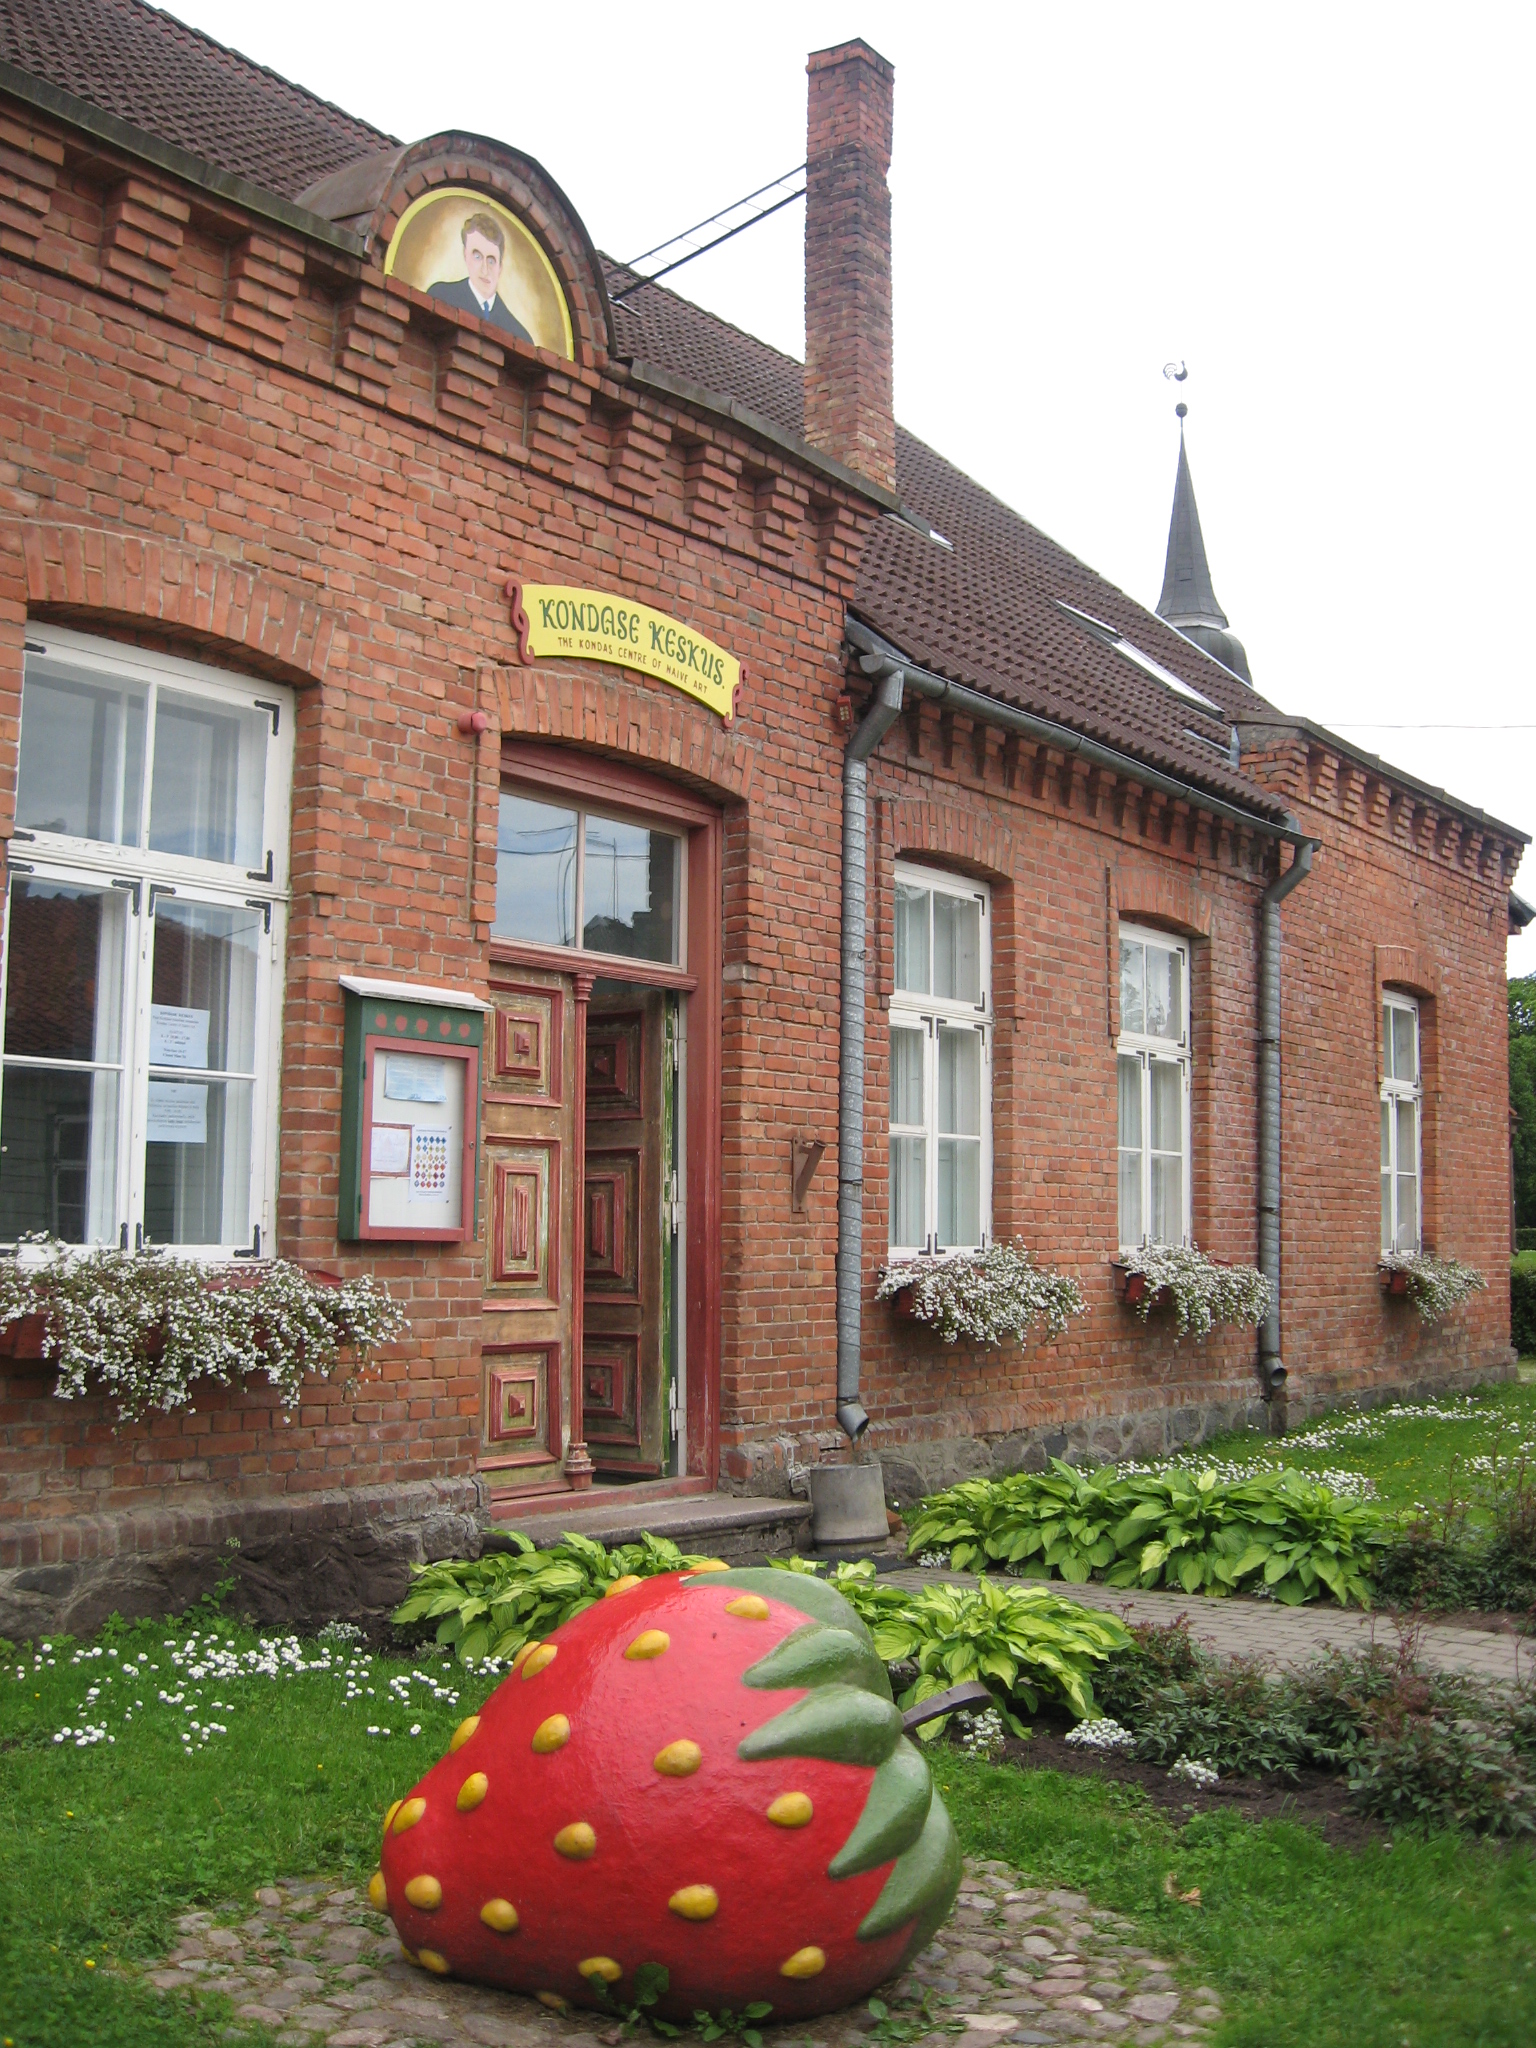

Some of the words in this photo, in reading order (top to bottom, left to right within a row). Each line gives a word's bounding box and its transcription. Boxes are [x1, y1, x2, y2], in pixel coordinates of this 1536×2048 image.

[539, 599, 640, 644] KONDASE
[649, 620, 725, 689] KESKUS.
[558, 637, 573, 648] THE
[579, 639, 613, 655] KONDAS
[618, 648, 647, 665] CENTRE
[652, 658, 662, 670] OF
[666, 665, 689, 684] NAIVE
[693, 680, 708, 694] ART
